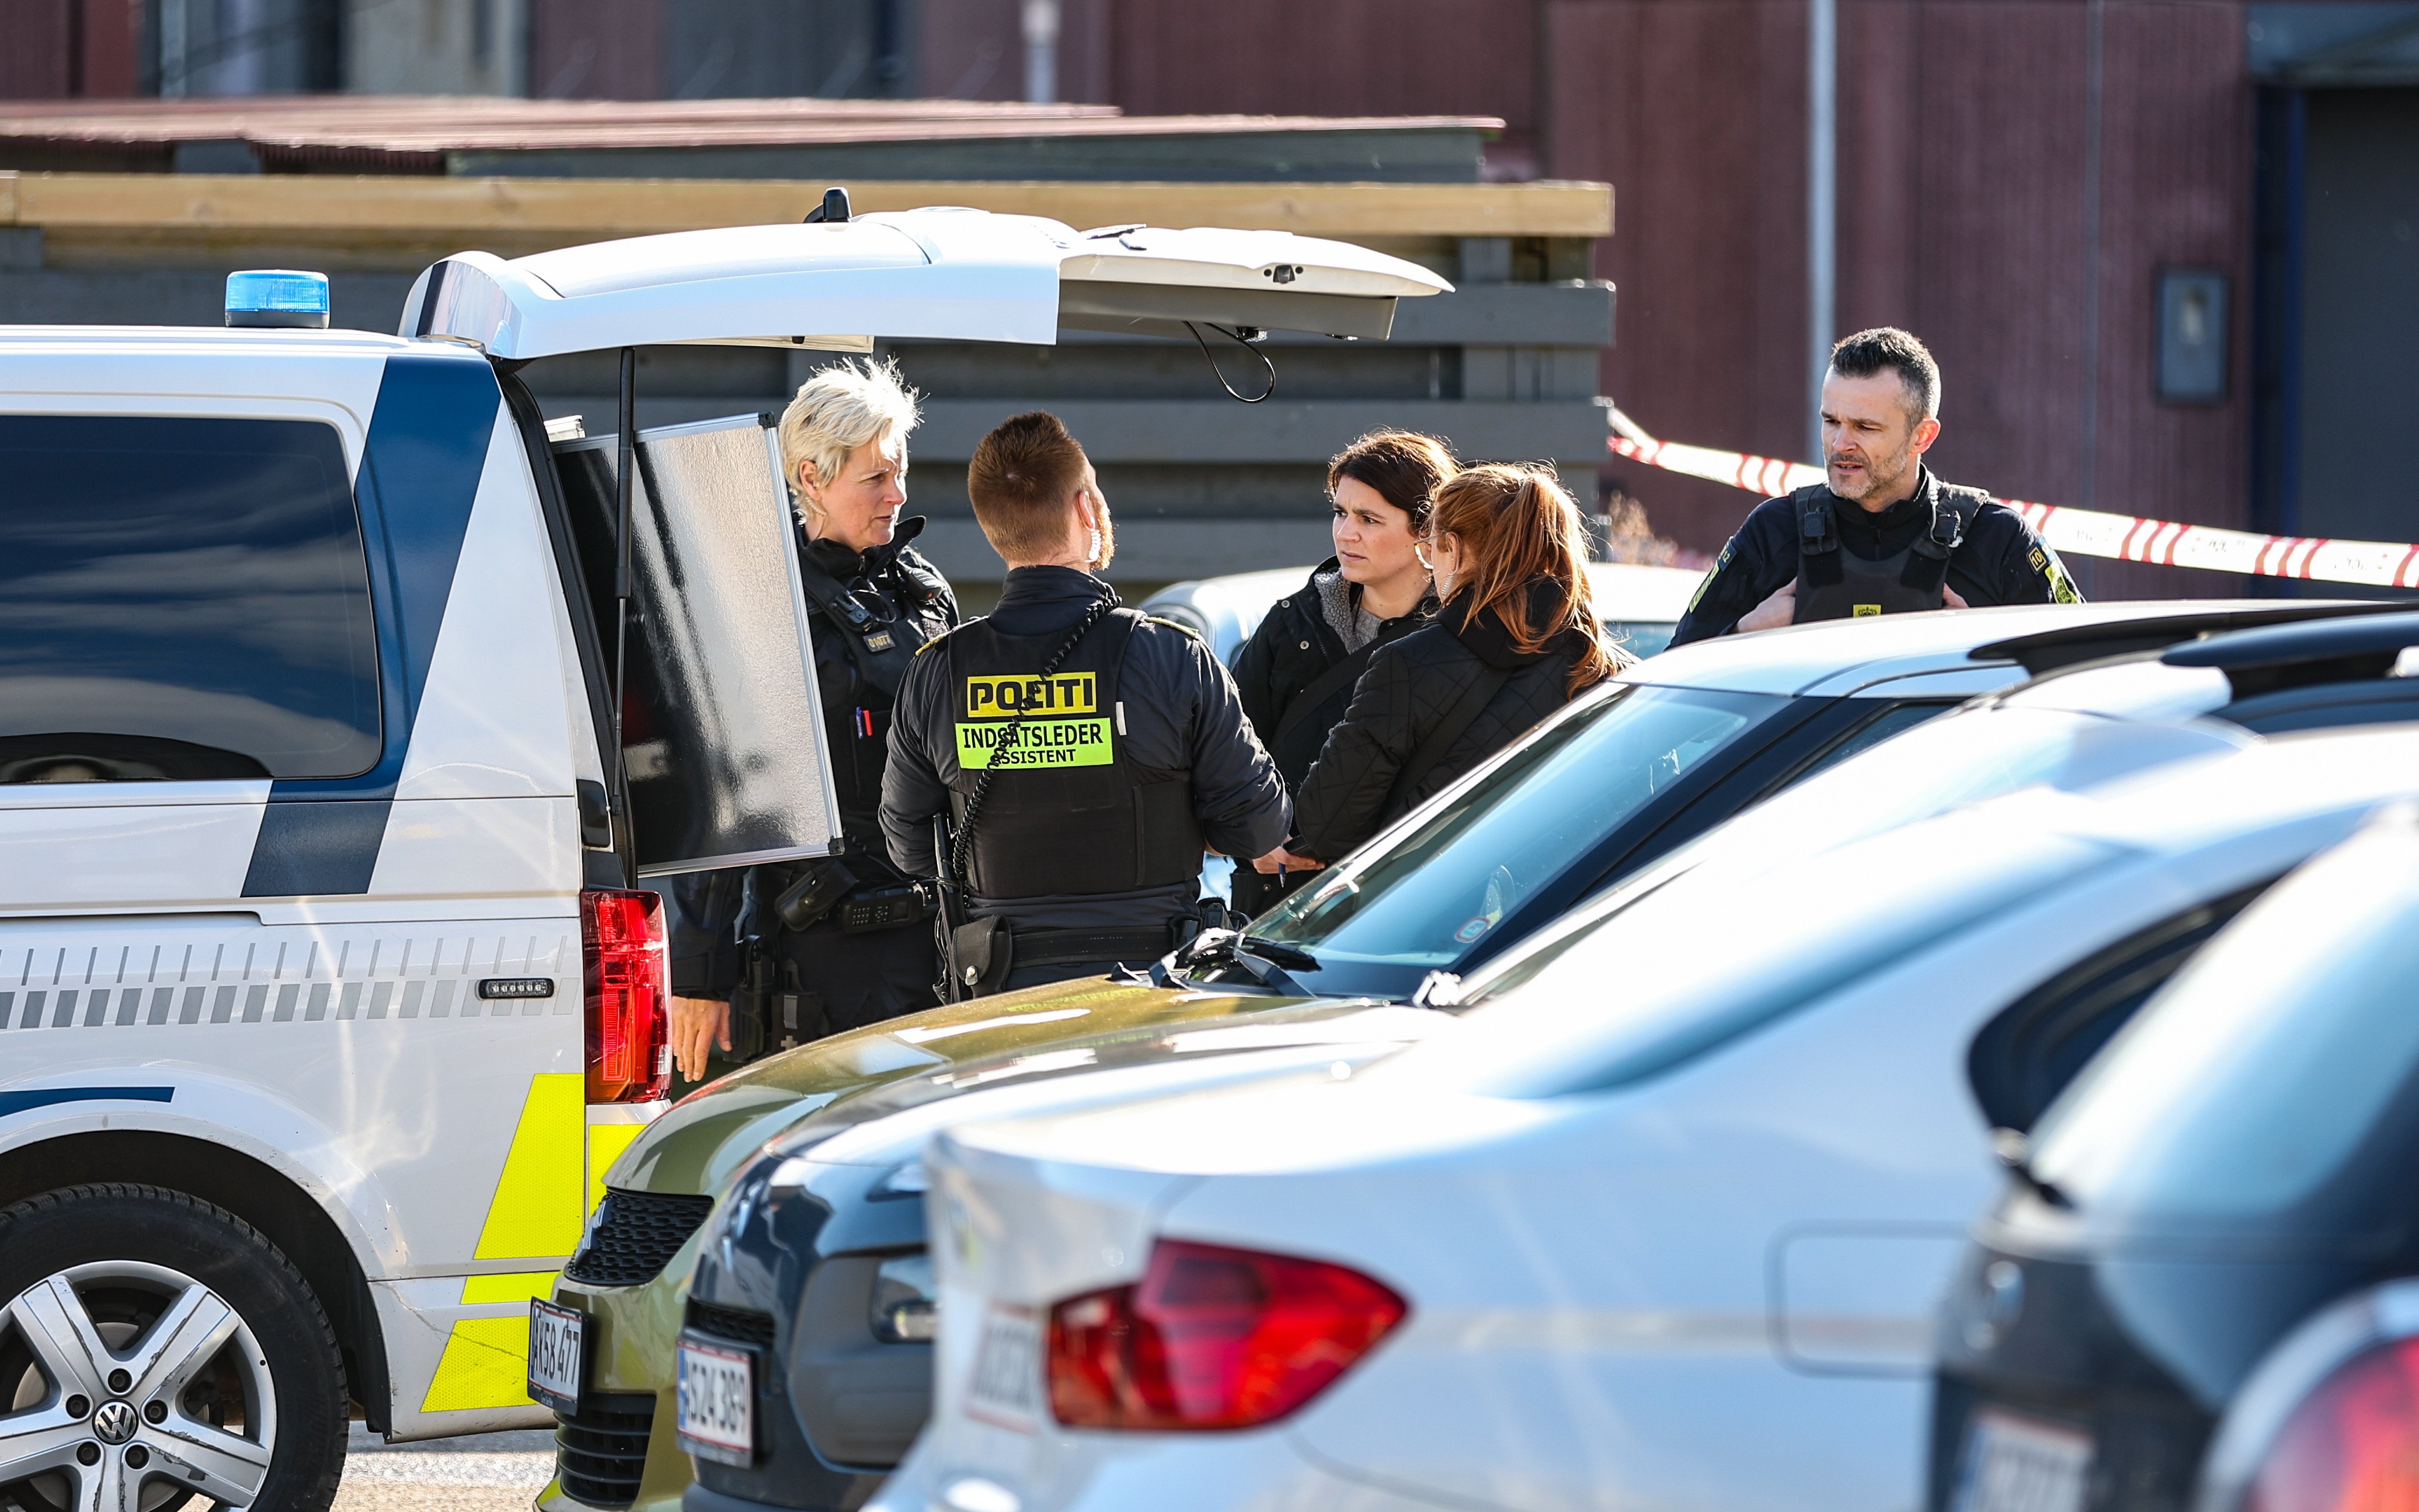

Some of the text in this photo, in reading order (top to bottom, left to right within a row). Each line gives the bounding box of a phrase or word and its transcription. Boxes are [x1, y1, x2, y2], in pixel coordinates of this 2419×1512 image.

[2032, 552, 2042, 566] 10
[970, 678, 1093, 710] POLITI
[963, 723, 1104, 748] INDSATSLEDER
[558, 1326, 579, 1384] 477
